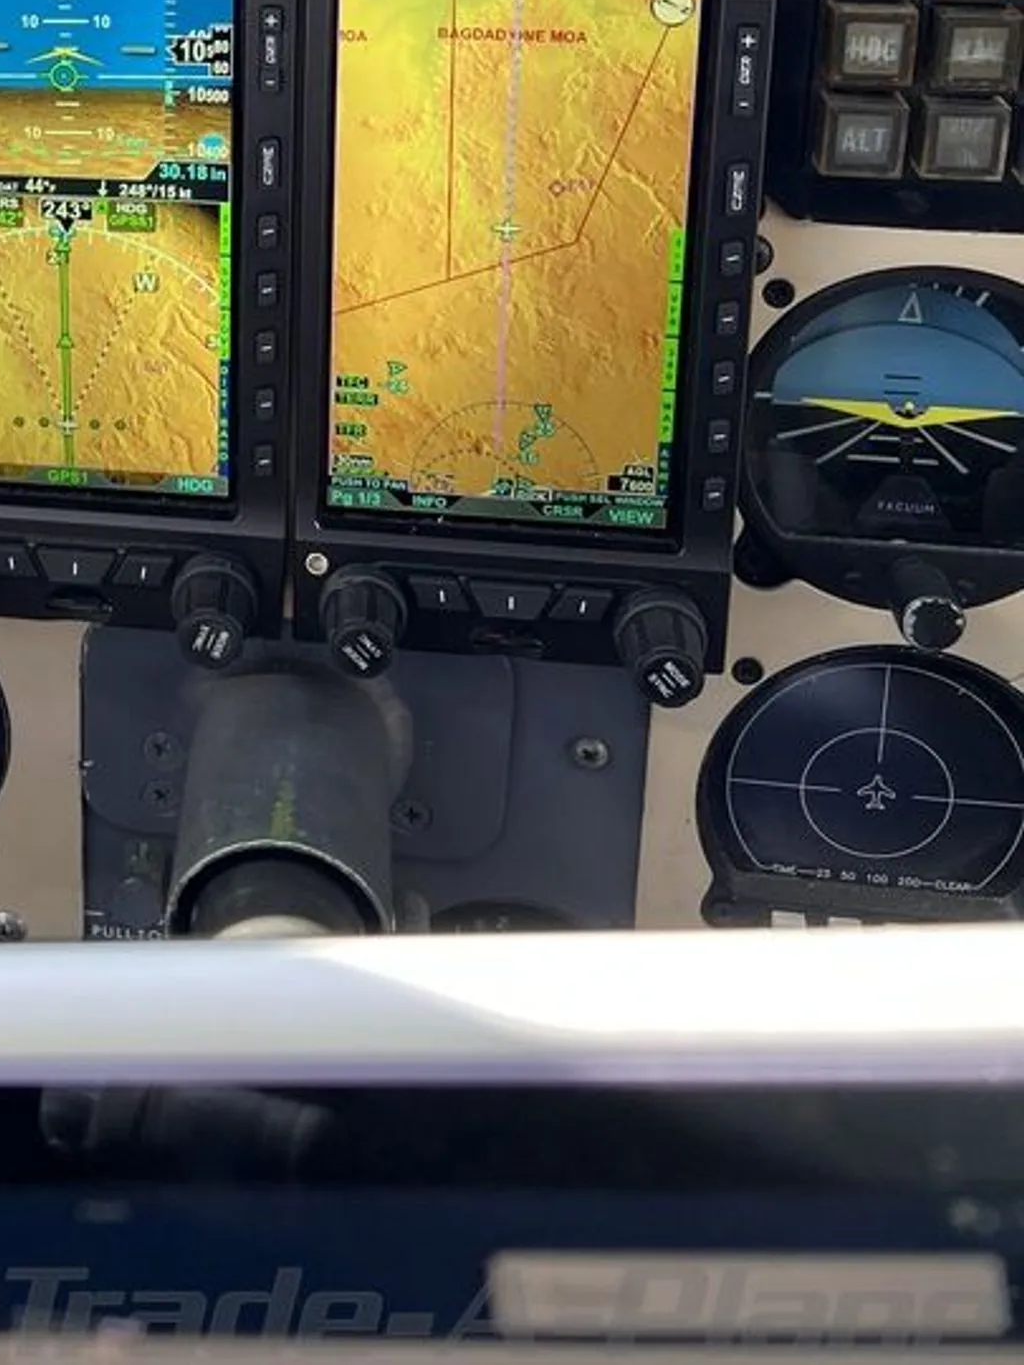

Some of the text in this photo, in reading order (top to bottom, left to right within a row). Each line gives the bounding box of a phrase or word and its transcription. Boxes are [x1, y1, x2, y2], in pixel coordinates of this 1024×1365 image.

[21, 15, 112, 29] 10 10
[438, 27, 588, 44] BAGDAD MOA
[846, 35, 897, 62] HDG
[187, 88, 229, 103] 10500
[24, 127, 116, 140] 10 10
[841, 127, 888, 153] ALT
[158, 163, 209, 180] 30.18
[116, 202, 148, 215] HDG
[133, 273, 158, 293] W
[48, 468, 88, 484] GPS1
[178, 477, 214, 493] HDG
[332, 492, 354, 508] Pg
[412, 495, 448, 509] INFO
[877, 499, 936, 514] VACUUM
[543, 505, 584, 518] CRSR
[609, 509, 654, 525] VIEW
[866, 873, 888, 884] 100
[91, 923, 134, 940] PULL
